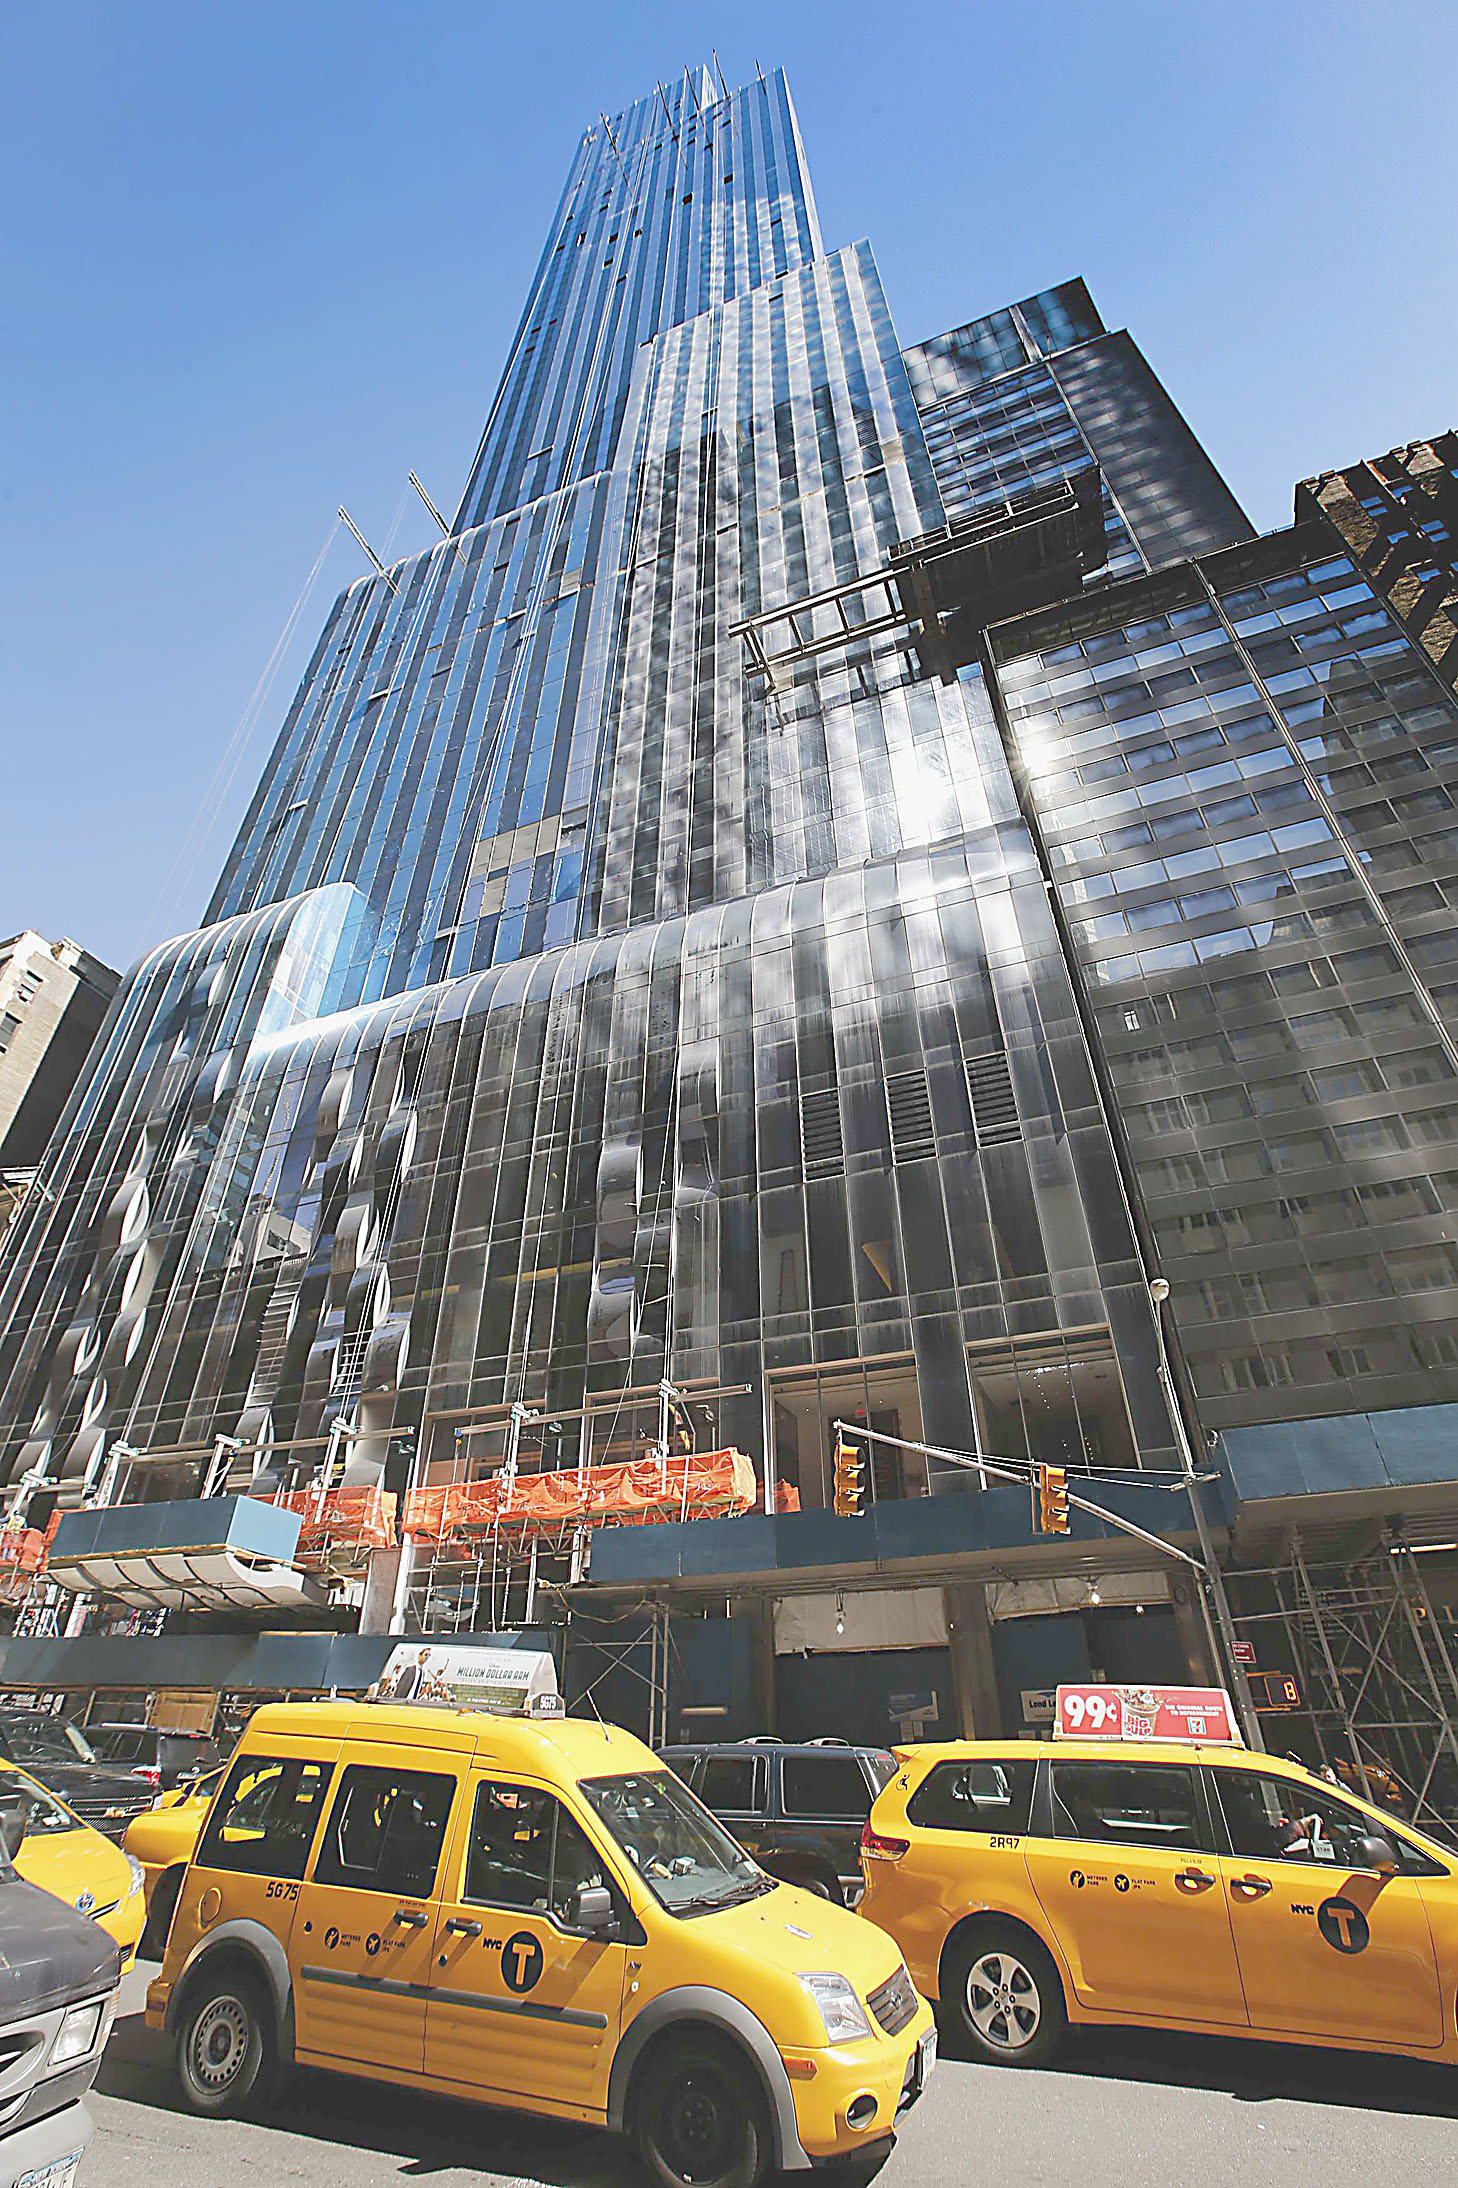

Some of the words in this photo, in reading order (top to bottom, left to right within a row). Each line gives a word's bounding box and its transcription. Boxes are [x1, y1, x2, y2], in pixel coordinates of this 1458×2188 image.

[457, 1666, 486, 1678] MILLION
[485, 1668, 513, 1680] DOLLAR
[512, 1670, 530, 1681] ARM
[1284, 1681, 1297, 1701] 13
[540, 1695, 557, 1710] 5G75
[1029, 1699, 1047, 1708] Lend
[1124, 1721, 1151, 1736] GULP
[990, 1836, 1020, 1849] 2R97
[265, 1882, 298, 1901] 5G75
[1291, 1903, 1315, 1916] NYC
[1327, 1906, 1355, 1947] T
[483, 1938, 503, 1950] NYC
[512, 1942, 535, 1985] T
